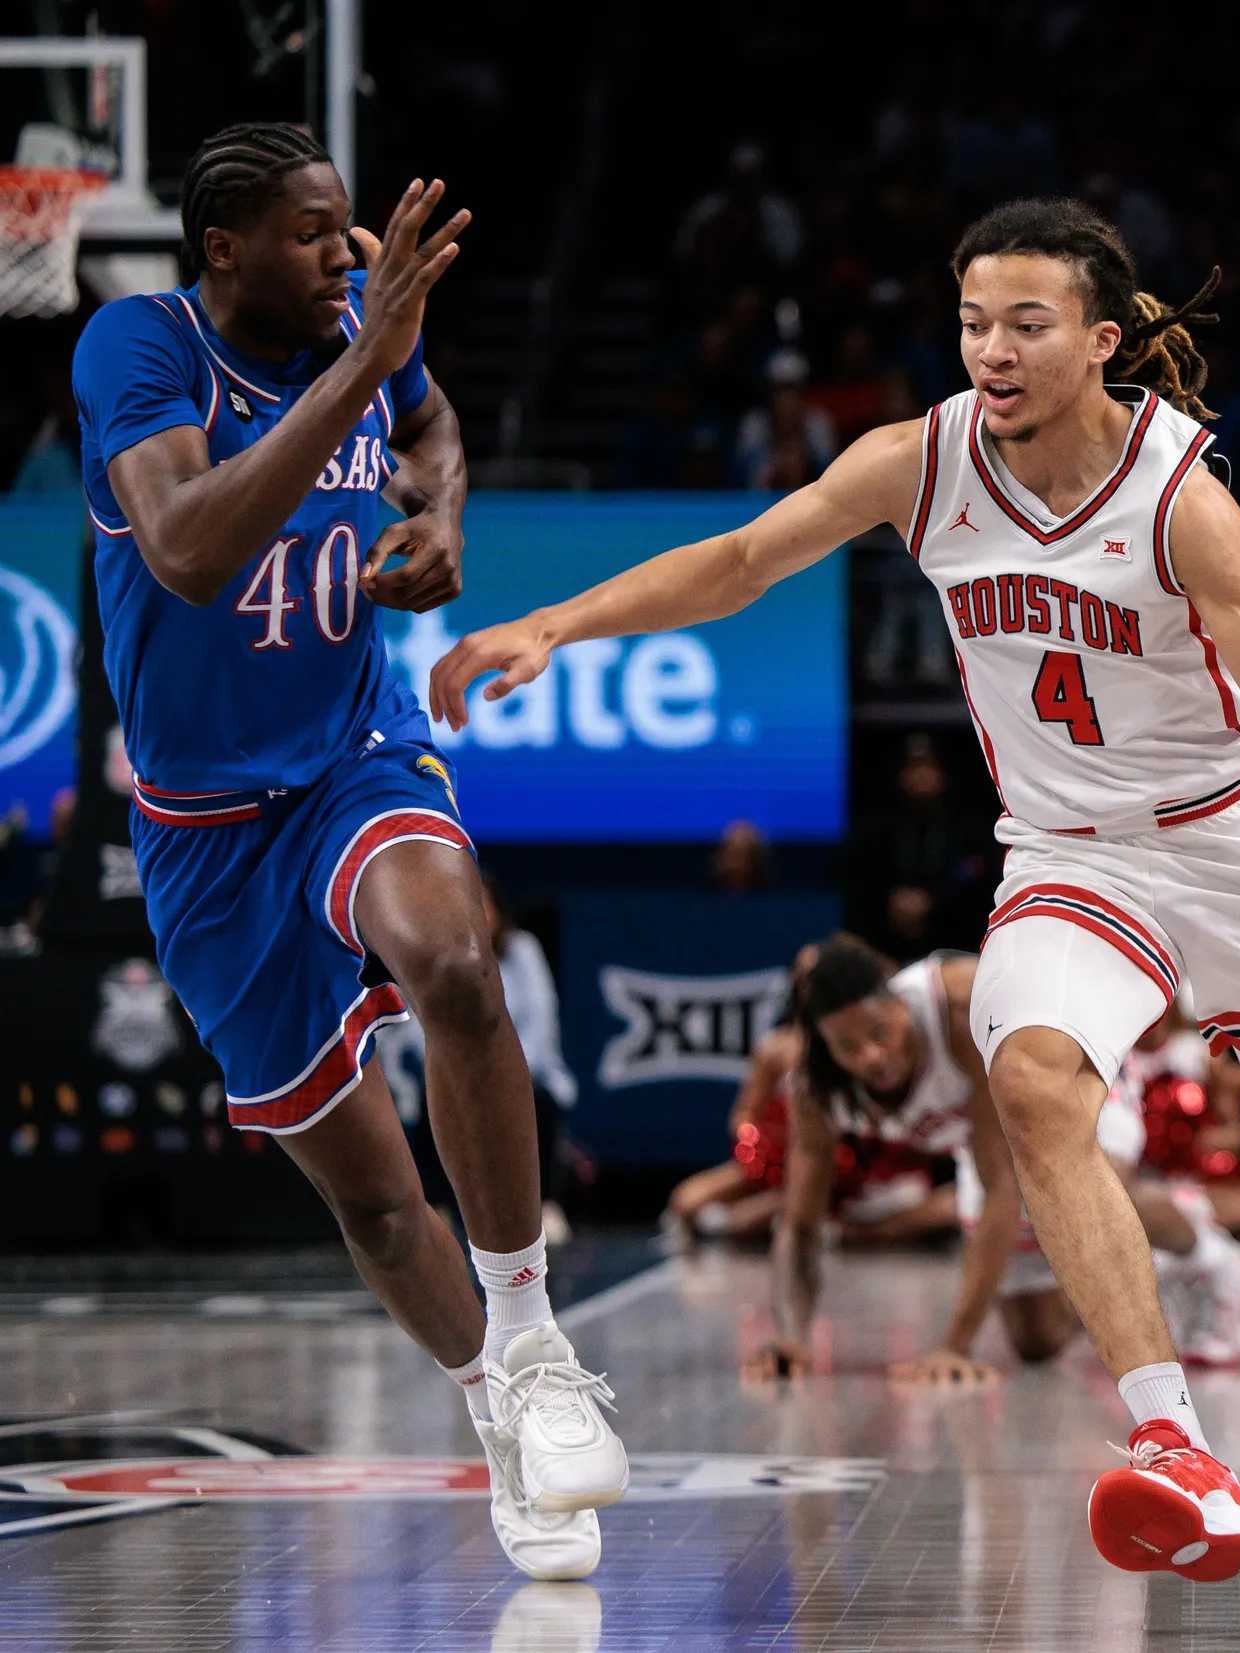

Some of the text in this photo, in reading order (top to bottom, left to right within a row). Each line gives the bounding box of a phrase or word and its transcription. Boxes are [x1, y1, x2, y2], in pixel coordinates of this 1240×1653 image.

[315, 435, 381, 491] SAS
[232, 521, 360, 651] 40
[947, 573, 1143, 657] HOUSTON
[385, 609, 719, 750] tate
[1031, 650, 1105, 746] 4
